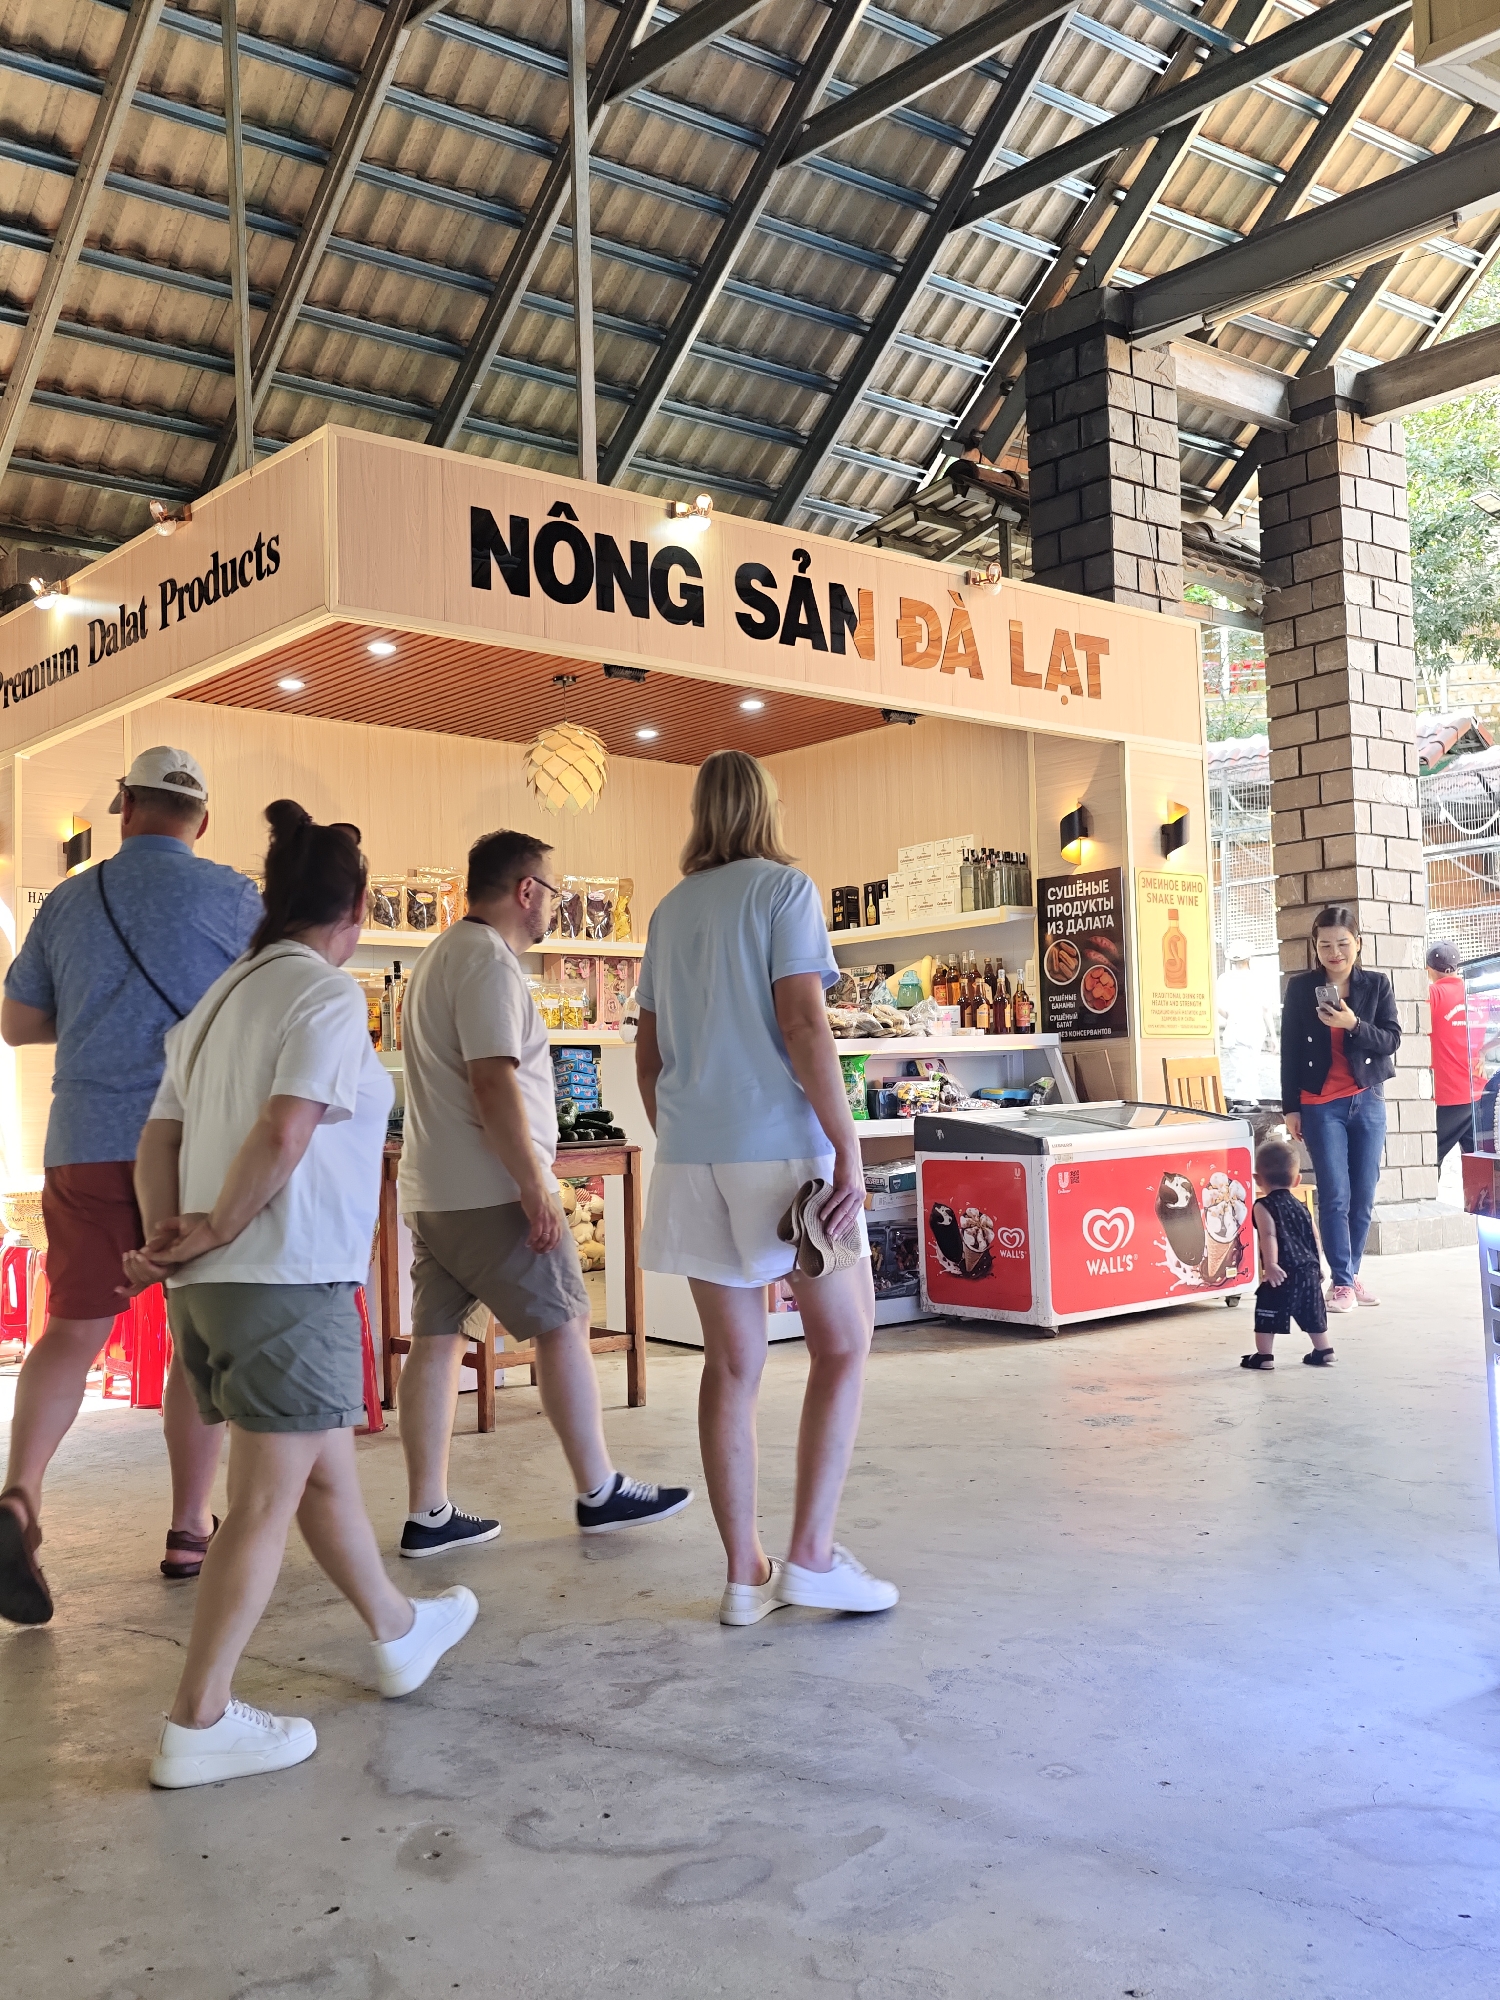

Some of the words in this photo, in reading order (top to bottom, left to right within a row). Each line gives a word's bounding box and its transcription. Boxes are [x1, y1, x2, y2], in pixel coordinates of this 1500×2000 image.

[87, 595, 148, 667] Dalat
[158, 531, 281, 631] Products
[470, 500, 705, 628] NÔNG
[735, 548, 876, 661] SẢN
[896, 589, 984, 680] ĐÀ
[1009, 618, 1110, 705] LẠT
[1047, 879, 1110, 901] СУШЁНЫЕ
[1141, 877, 1179, 891] ЗМЕИНОЕ
[1181, 880, 1203, 893] ВИНО
[1047, 896, 1114, 918] ПРОДУКТЫ
[1146, 892, 1175, 905] SNAKE
[1177, 895, 1199, 907] WINE
[1047, 920, 1064, 935] ИЗ
[1065, 914, 1115, 936] ДАЛАТА
[1056, 1021, 1073, 1029] БАТАТ
[1069, 1028, 1112, 1038] КОНСЕРВАНТОВ
